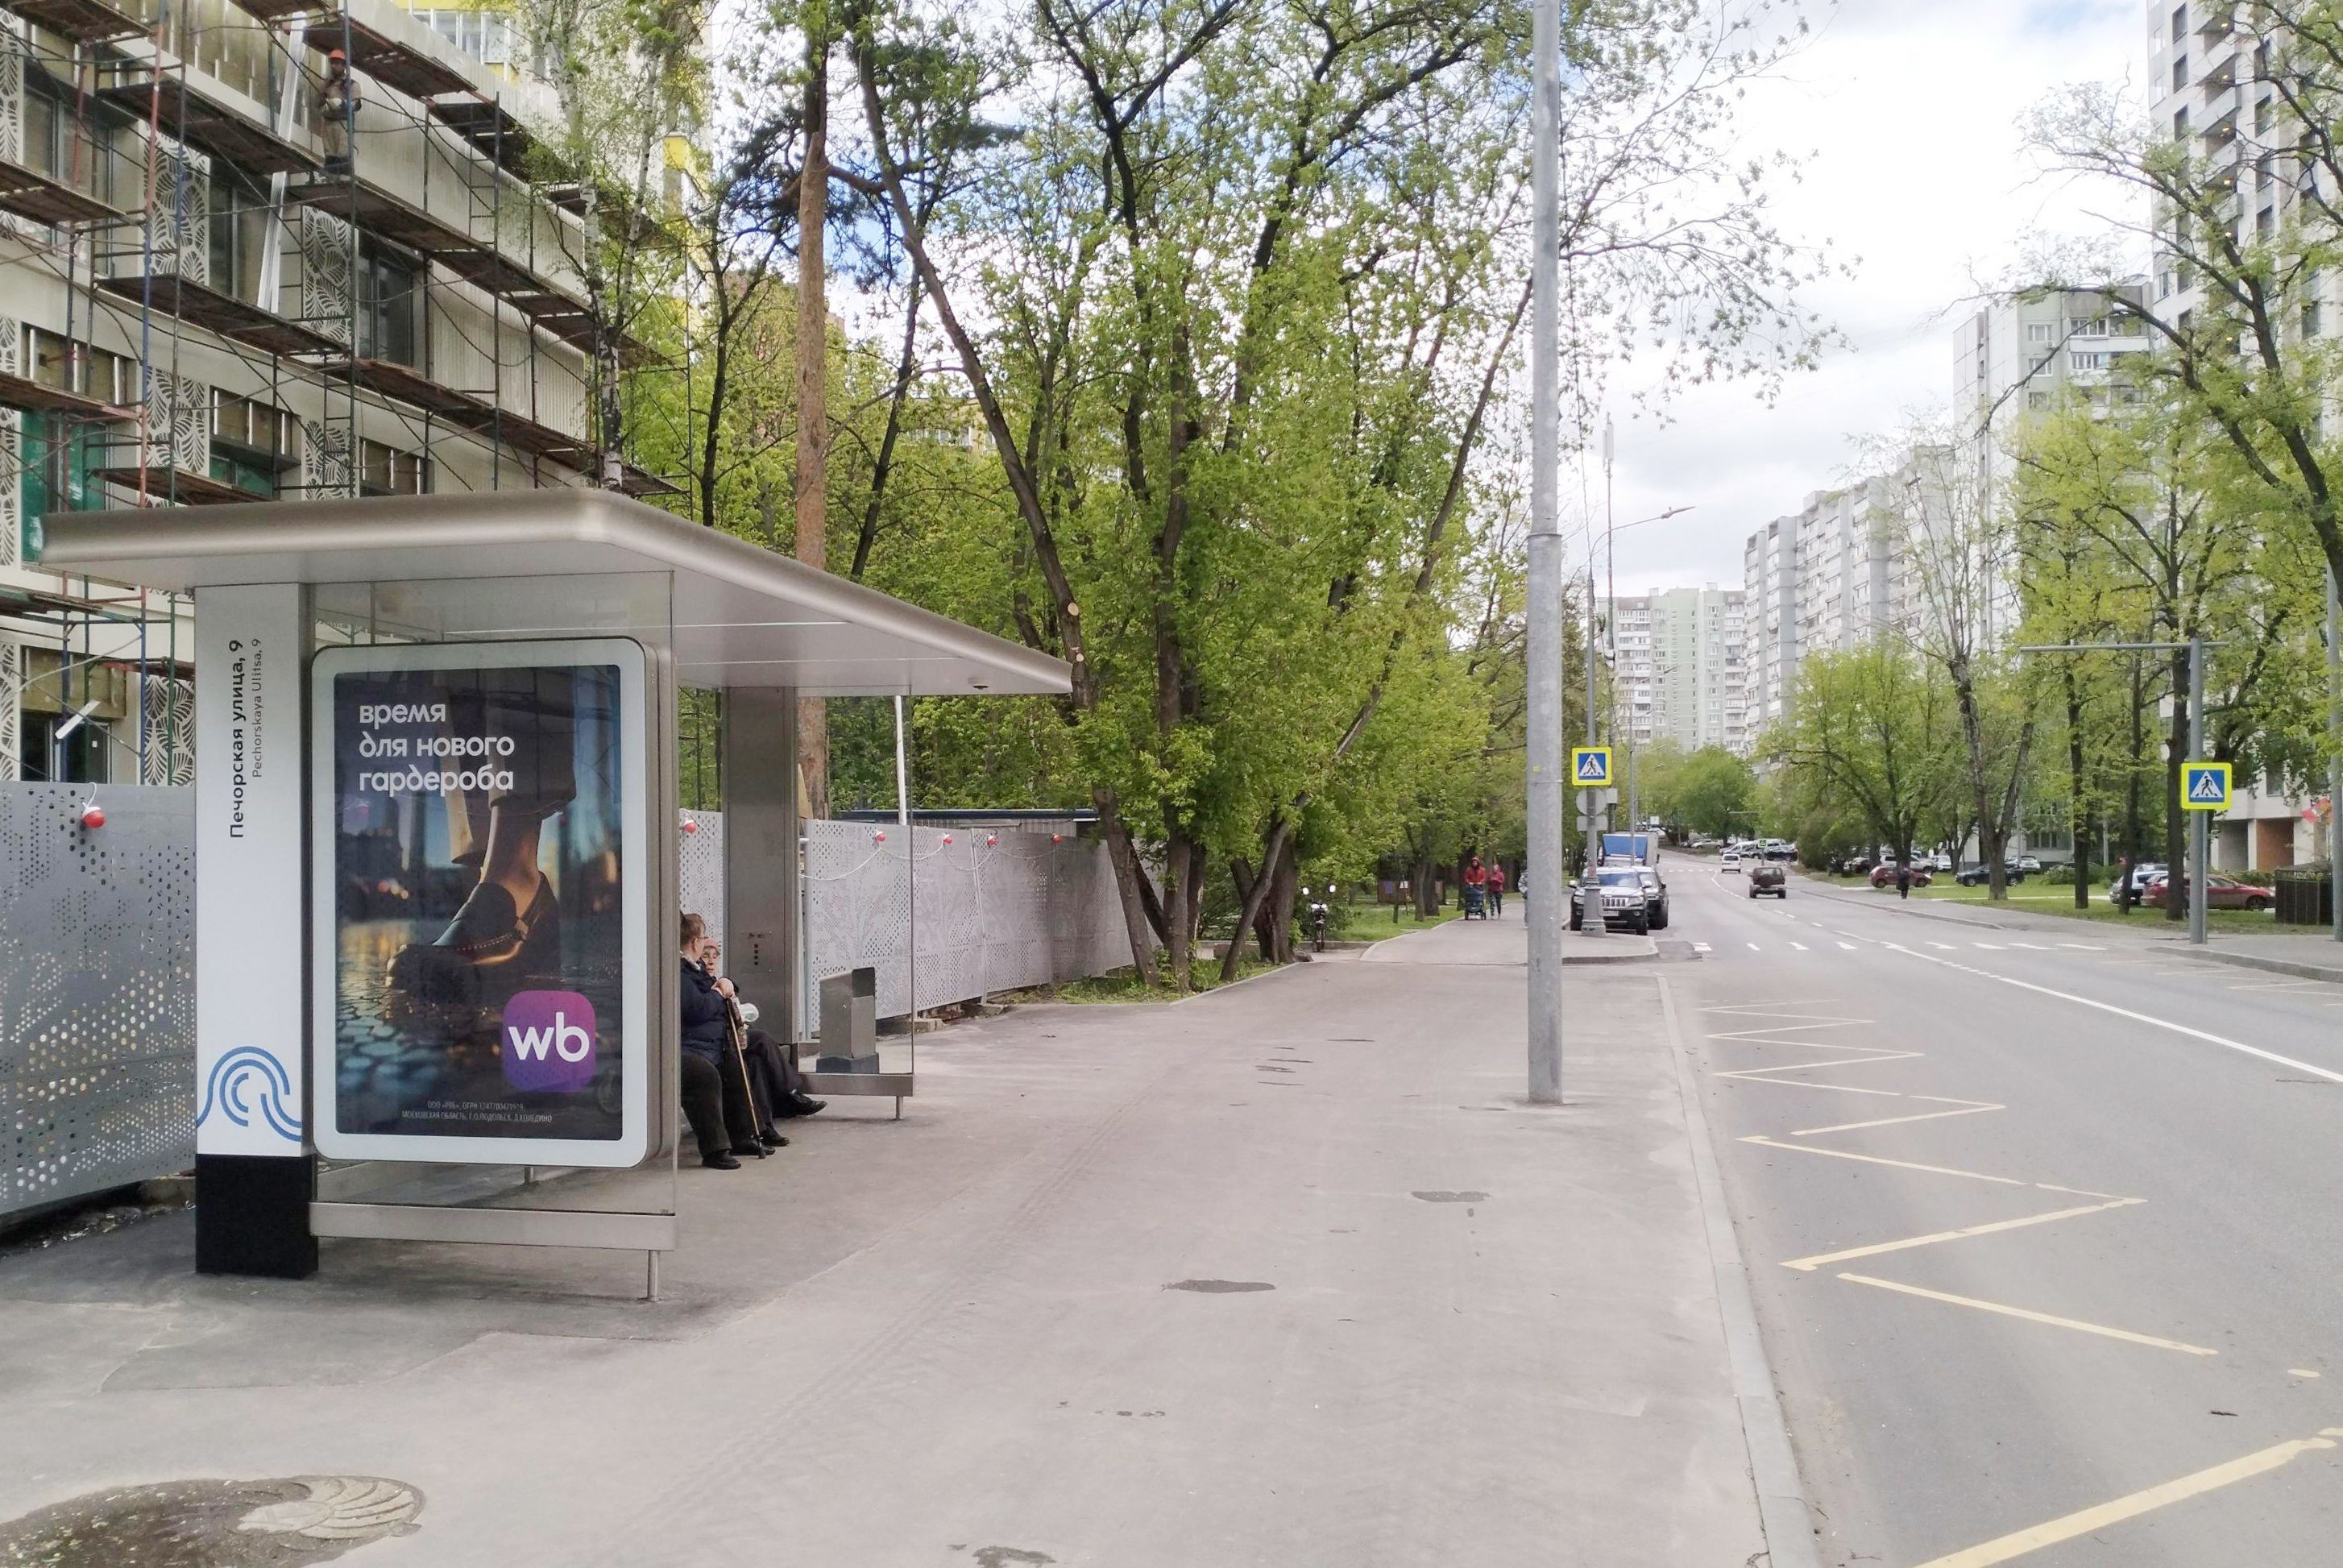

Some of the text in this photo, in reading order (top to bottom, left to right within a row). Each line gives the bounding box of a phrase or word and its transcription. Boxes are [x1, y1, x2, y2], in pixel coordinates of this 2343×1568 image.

[251, 638, 263, 778] Pechorskaya Ulitsa, 9
[359, 703, 446, 730] время
[228, 639, 247, 838] Печорская улица, 9
[359, 731, 515, 757] для нового
[359, 764, 514, 797] гардероба
[508, 1011, 590, 1063] wb
